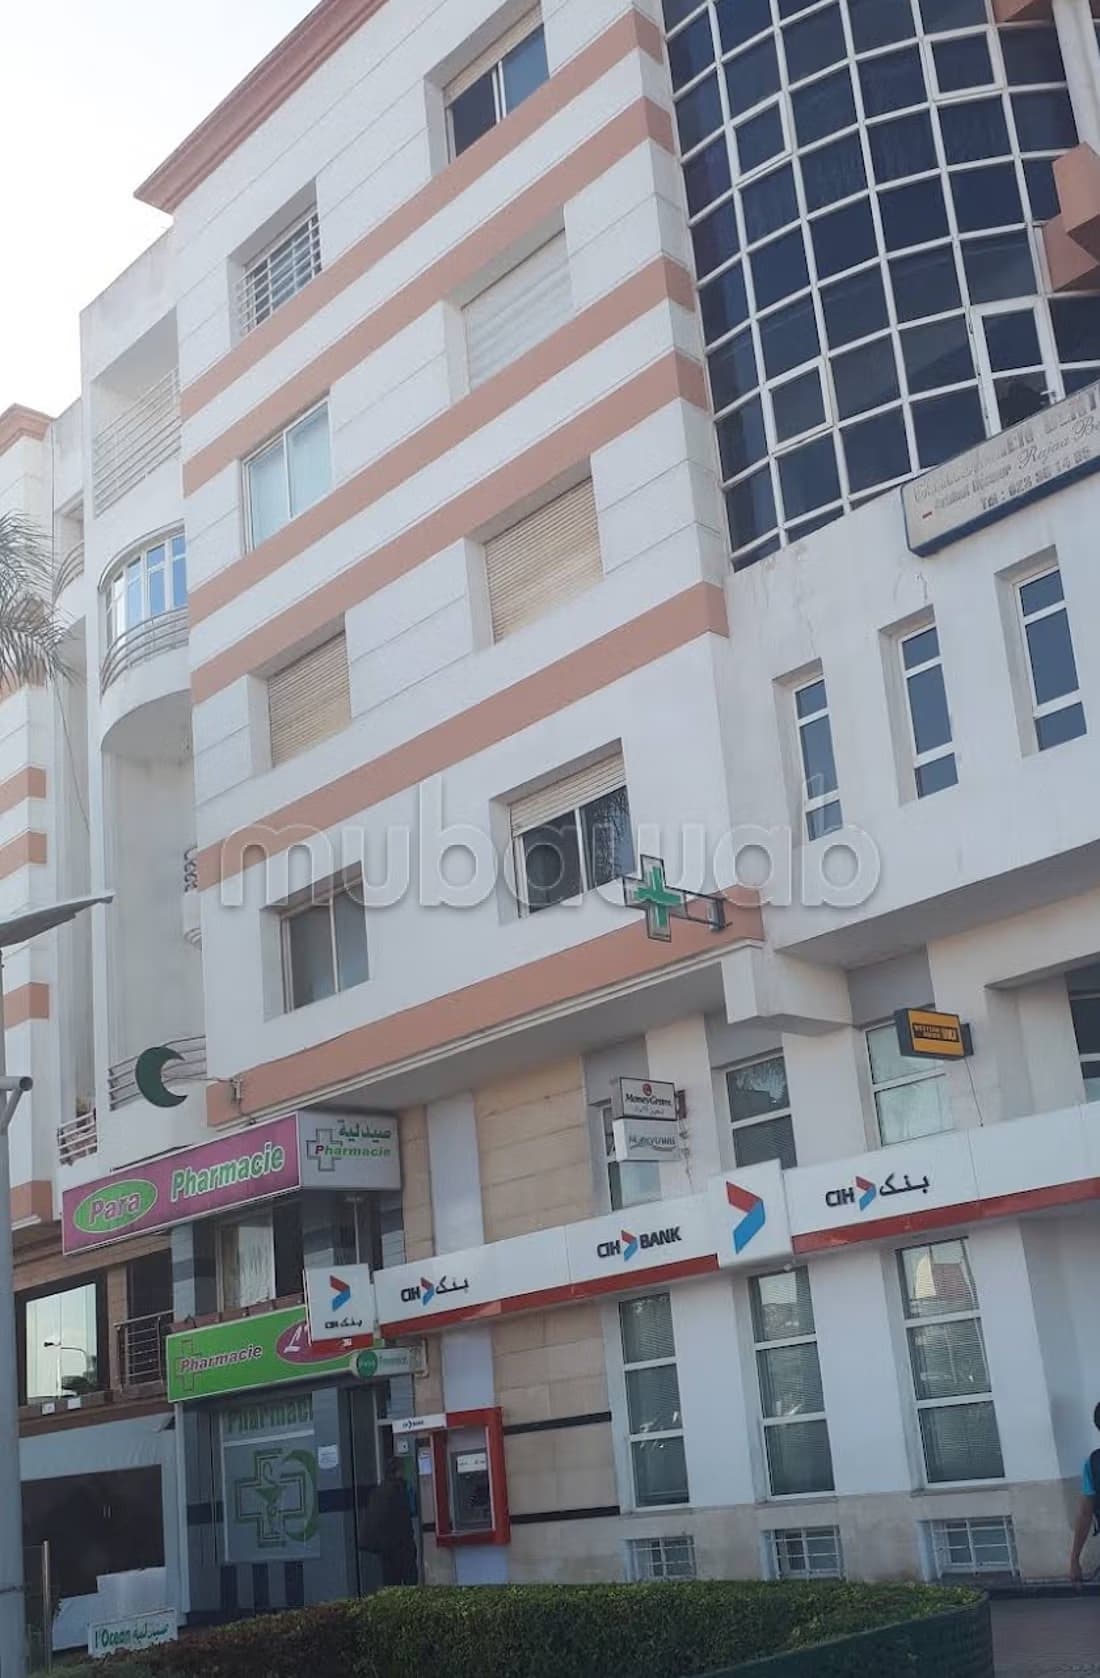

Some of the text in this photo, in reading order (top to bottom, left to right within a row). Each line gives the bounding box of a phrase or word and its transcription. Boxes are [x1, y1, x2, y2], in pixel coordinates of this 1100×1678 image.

[336, 1119, 392, 1144] صيدلية
[315, 1144, 392, 1157] Pharmacie
[87, 1140, 286, 1226] Para Pharmacie
[825, 1172, 930, 1208] CIH بنك
[596, 1225, 683, 1259] CIH BANK
[400, 1286, 421, 1303] CIH
[179, 1343, 264, 1374] Pharmacie
